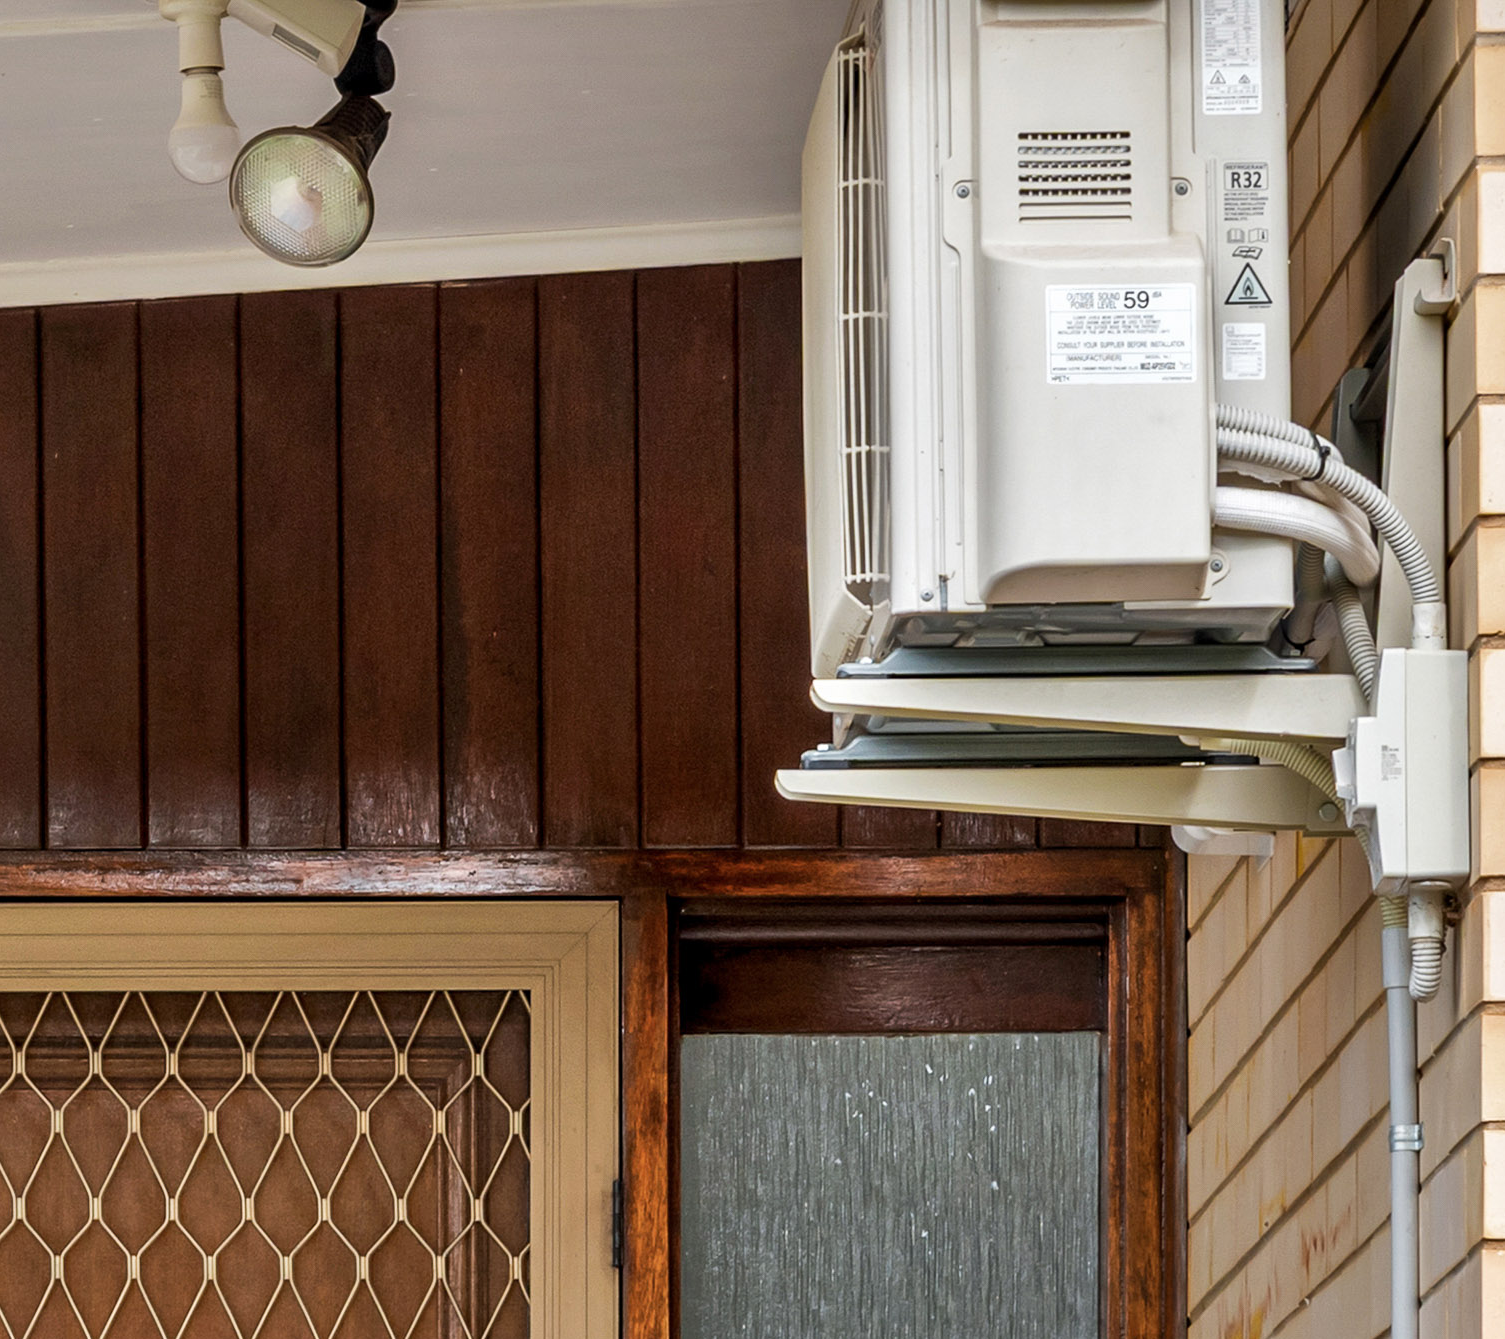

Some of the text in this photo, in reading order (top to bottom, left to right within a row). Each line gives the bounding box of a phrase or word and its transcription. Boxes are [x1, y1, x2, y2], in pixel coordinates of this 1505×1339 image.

[1231, 171, 1262, 189] R32
[1067, 292, 1094, 301] OUTSIDE
[1098, 292, 1120, 301] SOUND
[1124, 291, 1150, 309] 59
[1071, 300, 1117, 309] POWER LEVEL
